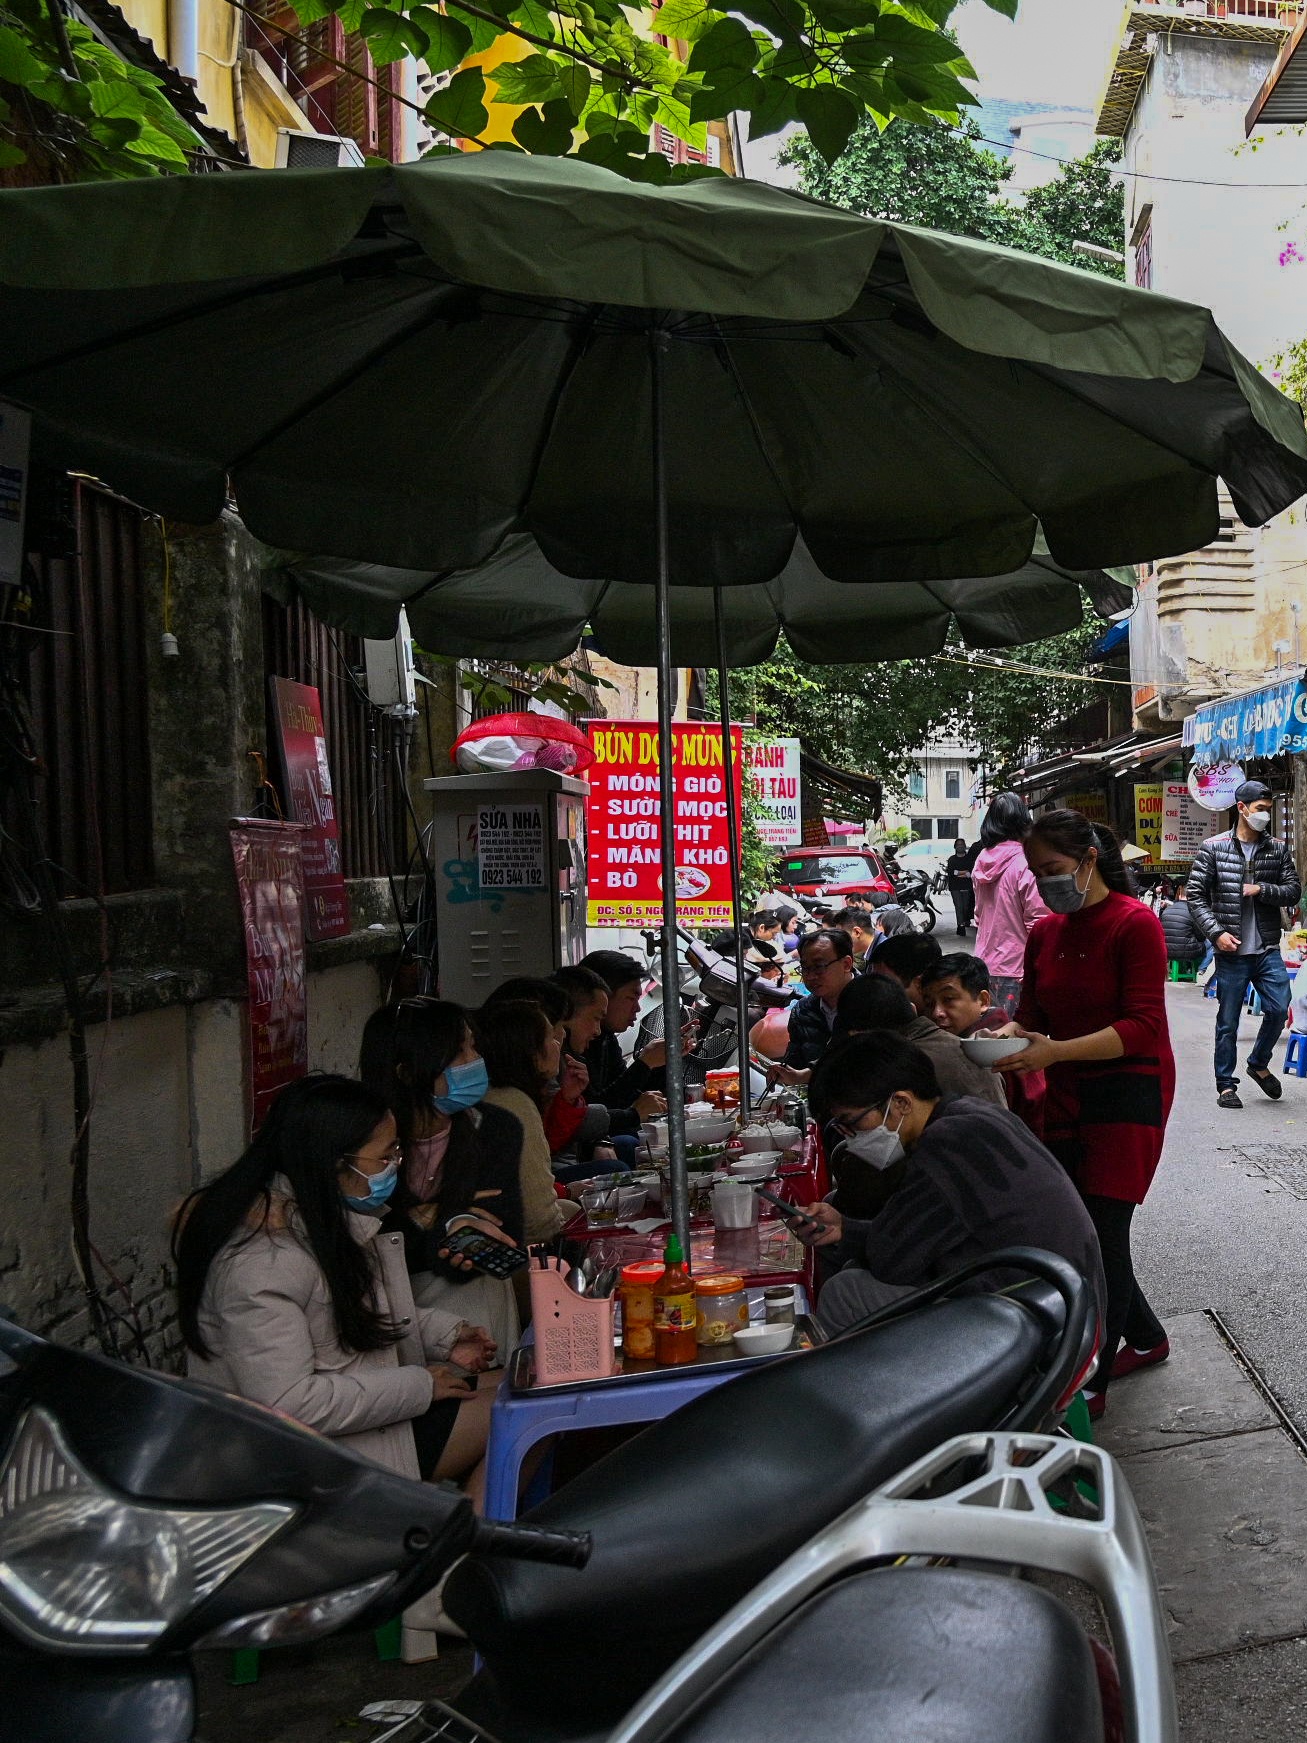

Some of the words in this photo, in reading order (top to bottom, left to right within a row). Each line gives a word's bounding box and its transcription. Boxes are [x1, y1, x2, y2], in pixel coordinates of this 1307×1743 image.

[593, 722, 633, 764] BÚN
[607, 772, 677, 792] MÓN
[683, 773, 722, 794] GIÒ
[770, 773, 797, 799] TÀU
[1167, 786, 1189, 794] CH
[480, 804, 508, 829] SỬA
[512, 808, 542, 829] NHÀ
[678, 800, 728, 822] MỌC
[607, 820, 658, 840] LƯỠI
[673, 824, 713, 845] HỊT
[607, 844, 662, 864] MĂN
[683, 848, 728, 865] KHÔ
[482, 869, 504, 885] 0923
[507, 869, 523, 885] 544
[525, 869, 542, 884] 192
[607, 868, 638, 888] BÒ
[597, 906, 615, 915] ĐC:
[618, 904, 632, 915] SỐ
[635, 906, 642, 915] 5
[676, 904, 704, 916] RÀNG
